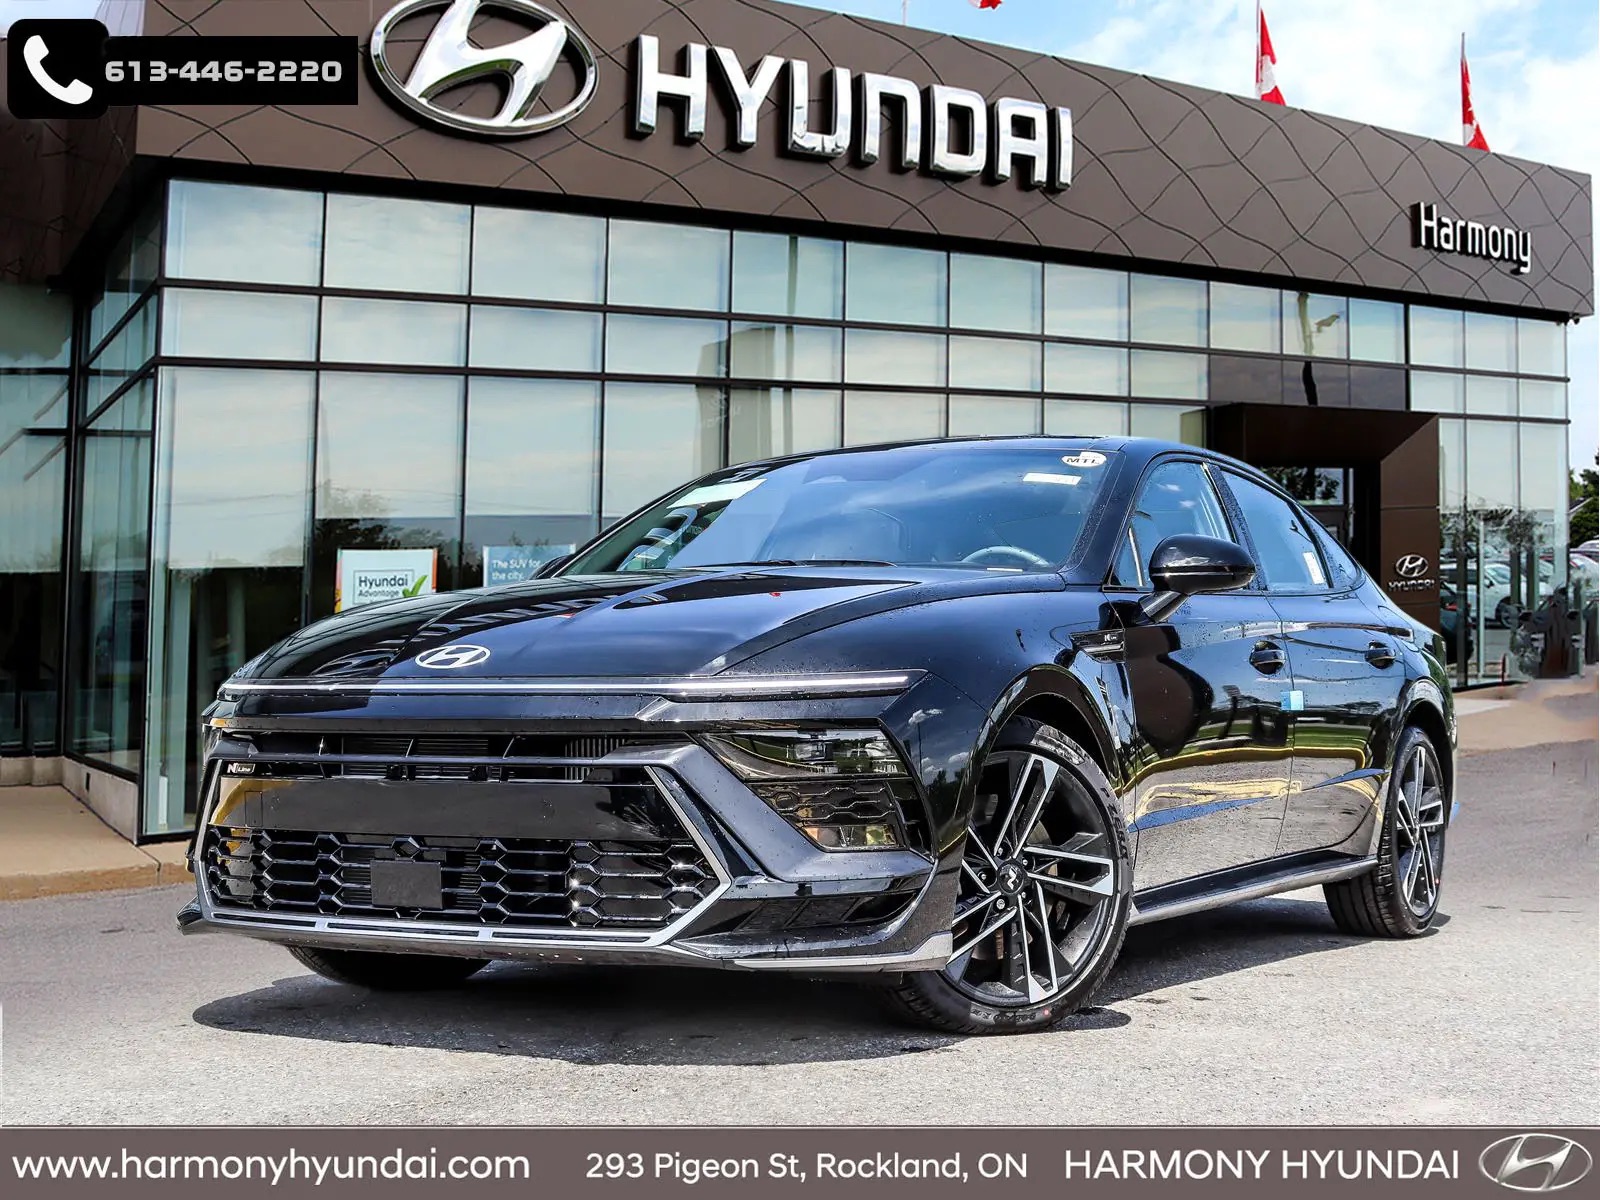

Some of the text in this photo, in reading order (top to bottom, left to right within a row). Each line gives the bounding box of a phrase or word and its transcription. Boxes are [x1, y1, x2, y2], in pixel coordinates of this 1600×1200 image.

[636, 34, 1074, 190] HYUNDAI
[1419, 201, 1522, 273] Harmony
[491, 559, 508, 568] The
[509, 558, 528, 568] SUV
[358, 574, 409, 589] Hyundai
[491, 571, 506, 580] the
[358, 589, 400, 598] Advantage
